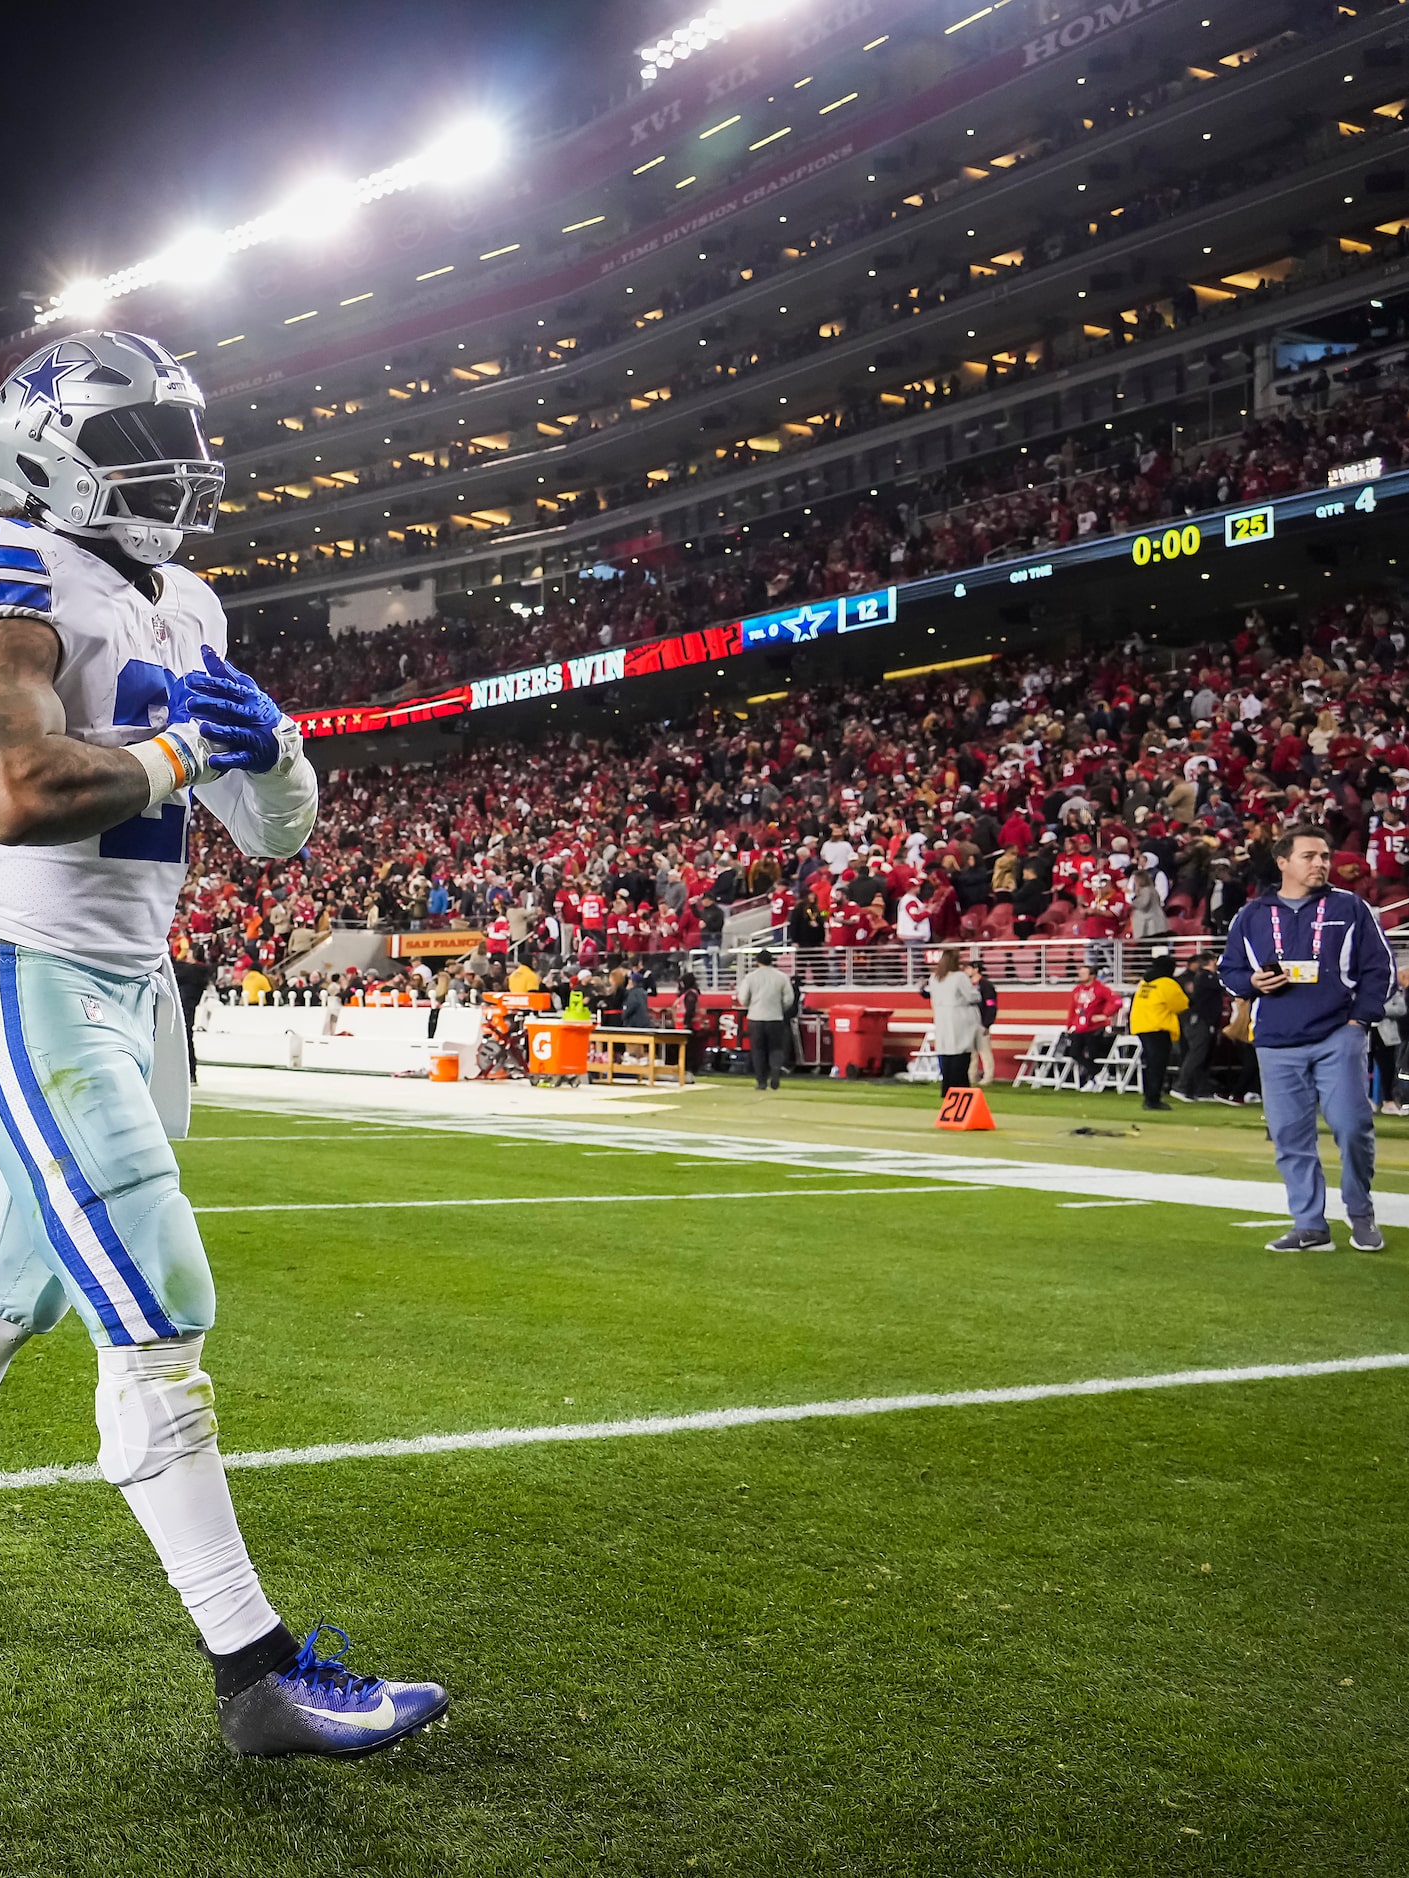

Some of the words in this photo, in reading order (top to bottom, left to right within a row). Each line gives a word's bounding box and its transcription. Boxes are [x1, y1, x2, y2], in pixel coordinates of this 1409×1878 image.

[1022, 0, 1160, 68] HOM
[630, 99, 683, 147] XVI
[664, 200, 739, 245] DIVISION
[742, 143, 854, 204] CHAMPIONS
[1315, 502, 1346, 519] QTR
[1355, 486, 1377, 513] 4
[1235, 515, 1266, 540] 25
[1132, 525, 1201, 566] 0:00
[1009, 569, 1028, 583] ON
[856, 599, 879, 621] 12
[768, 623, 779, 638] 0
[469, 663, 563, 711] NINERS
[568, 649, 627, 690] WIN
[1383, 835, 1406, 853] 15
[582, 902, 600, 918] 42
[406, 939, 430, 949] SAN
[532, 1031, 552, 1060] G
[939, 1092, 974, 1122] 20
